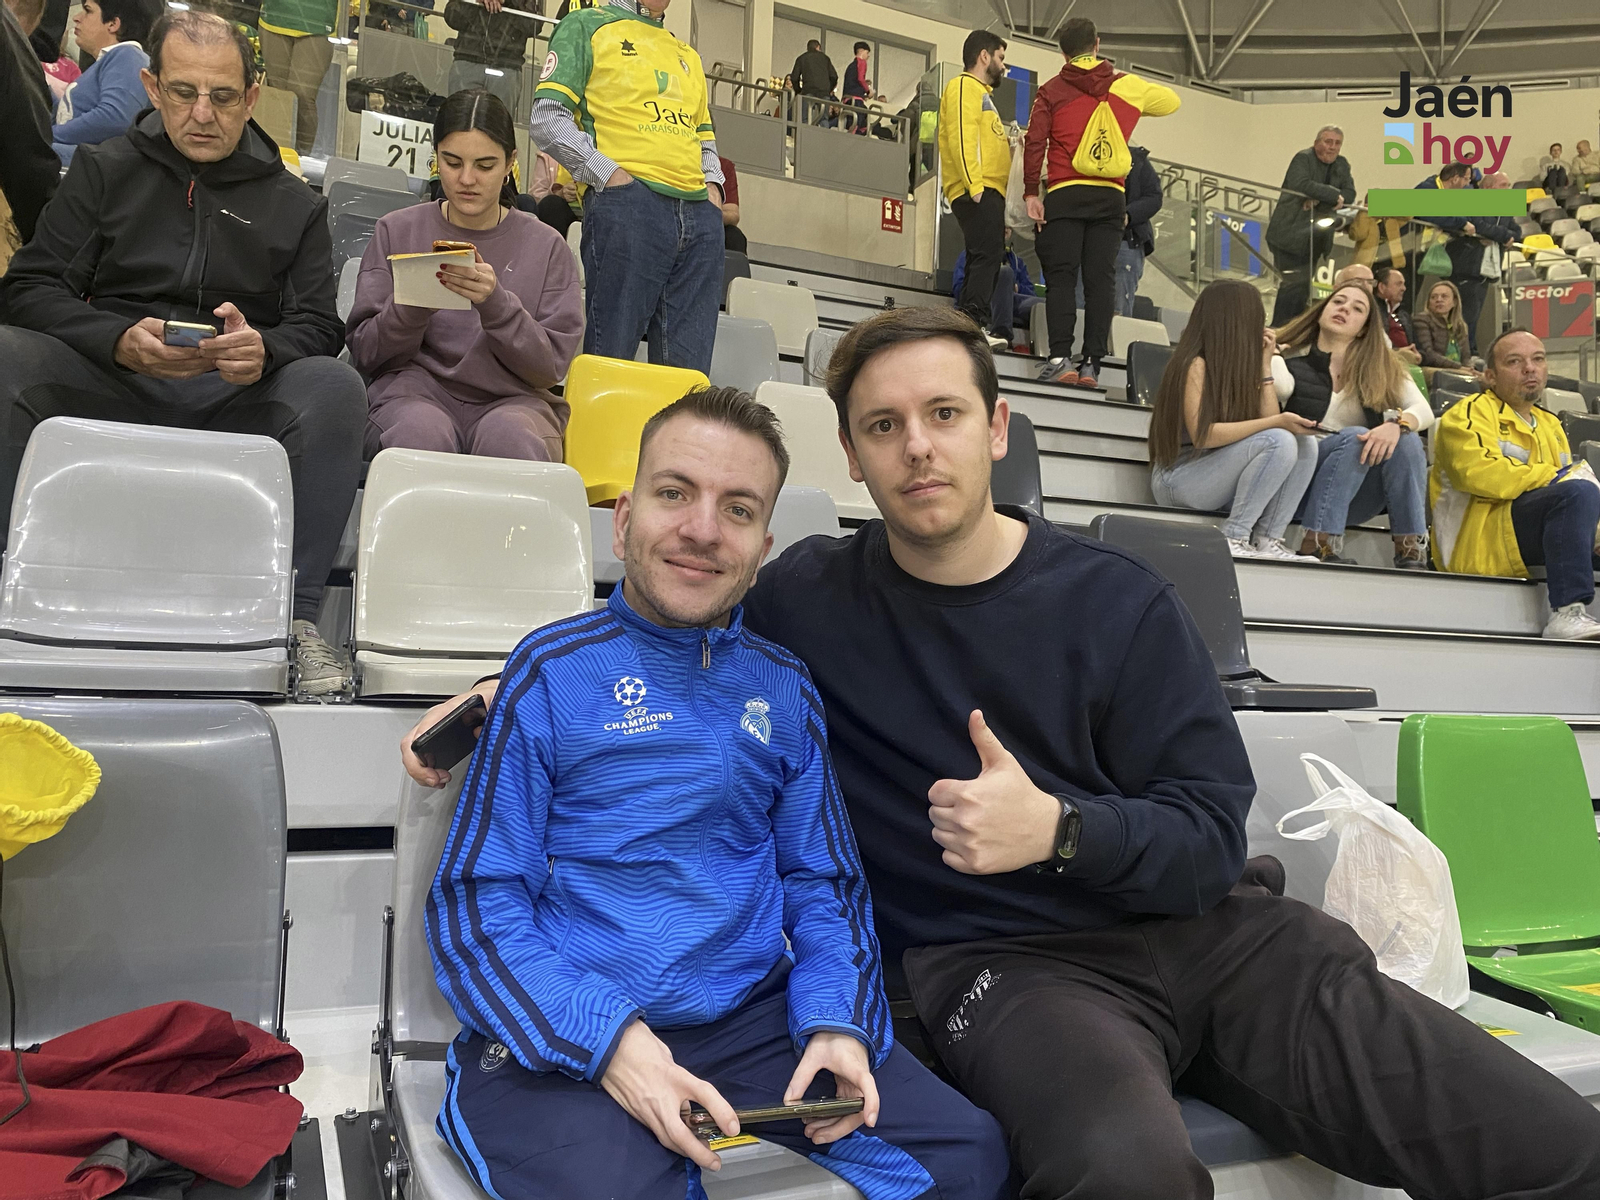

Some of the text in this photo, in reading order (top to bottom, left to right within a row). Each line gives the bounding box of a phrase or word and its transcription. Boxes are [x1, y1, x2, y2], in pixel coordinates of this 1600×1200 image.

[372, 120, 433, 144] JULIA
[638, 123, 680, 136] PARAÍSO
[387, 144, 416, 175] 21
[1515, 286, 1574, 301] Sector
[1519, 281, 1595, 338] 12
[603, 712, 674, 731] CHAMPIONS
[624, 707, 648, 719] UEFA
